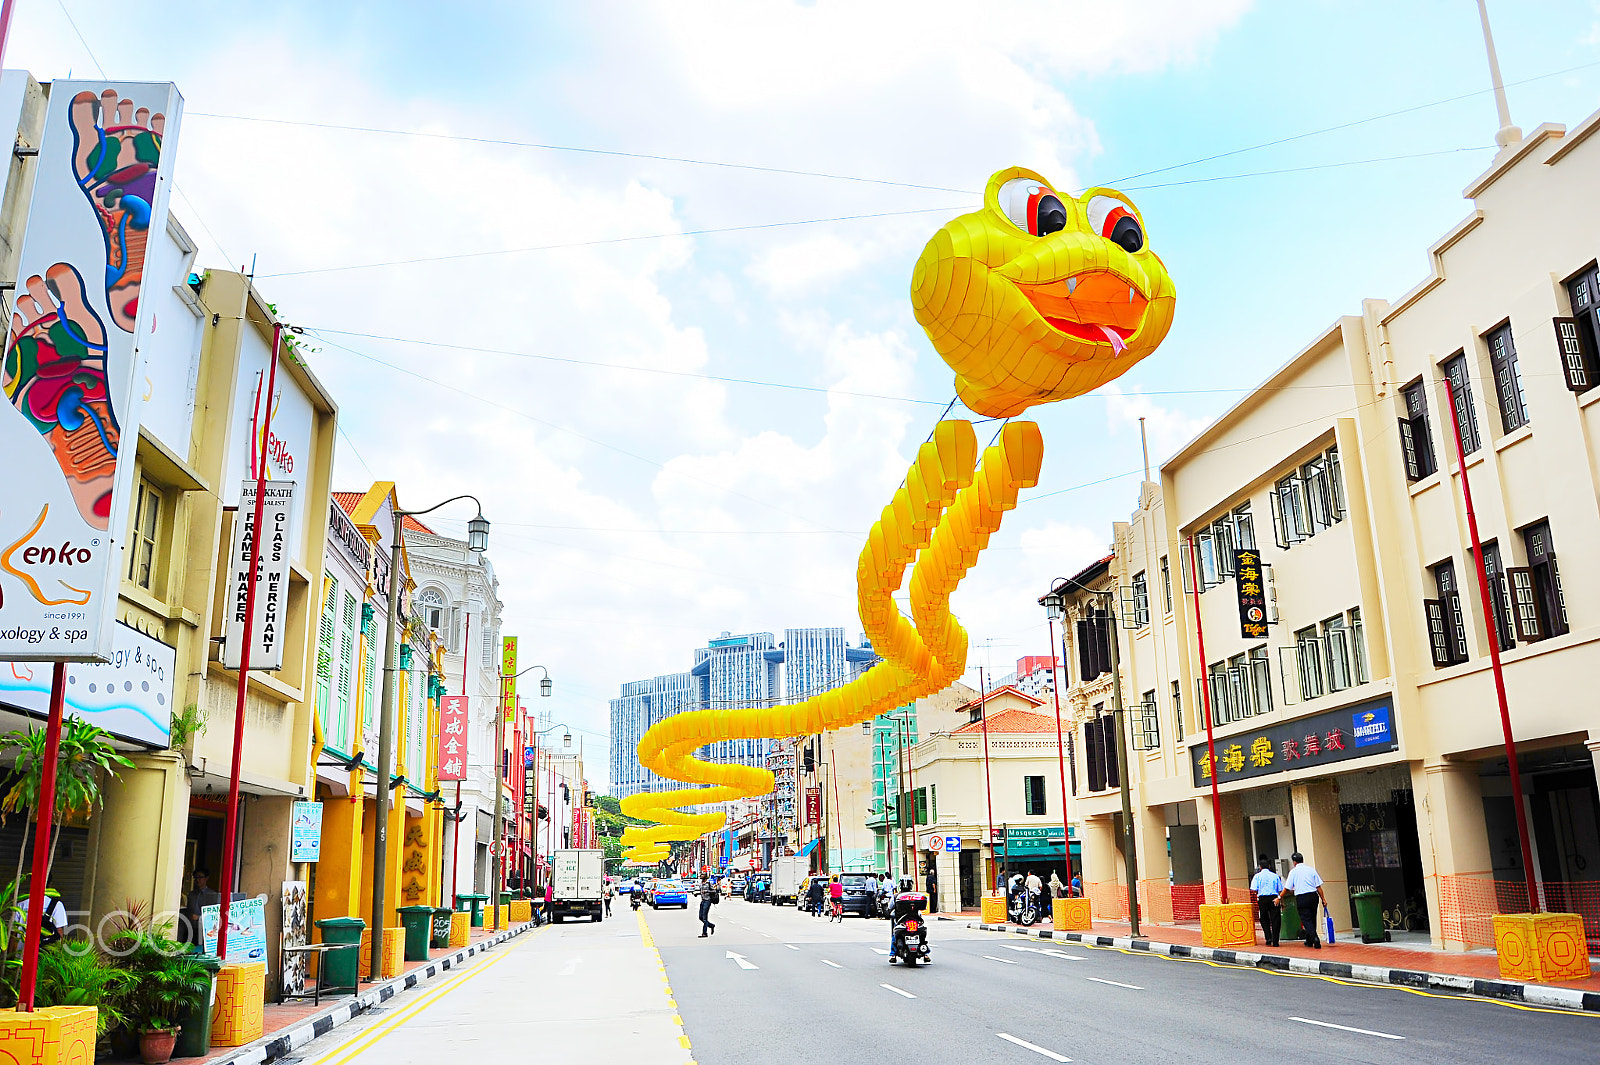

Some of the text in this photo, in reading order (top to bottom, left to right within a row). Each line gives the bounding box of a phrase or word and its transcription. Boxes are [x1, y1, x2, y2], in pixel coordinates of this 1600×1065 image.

[243, 488, 292, 498] BARKKATH
[247, 499, 286, 507] SPIALIST
[235, 512, 254, 623] FRAME MAKER
[263, 512, 286, 653] GLASS MERCHANT
[49, 627, 61, 640] &
[64, 629, 88, 643] spa
[135, 646, 142, 660] &
[146, 656, 164, 683] spa
[1009, 829, 1036, 837] Mosque
[240, 899, 263, 909] GLASS
[433, 919, 450, 928] 205
[433, 928, 449, 938] 207
